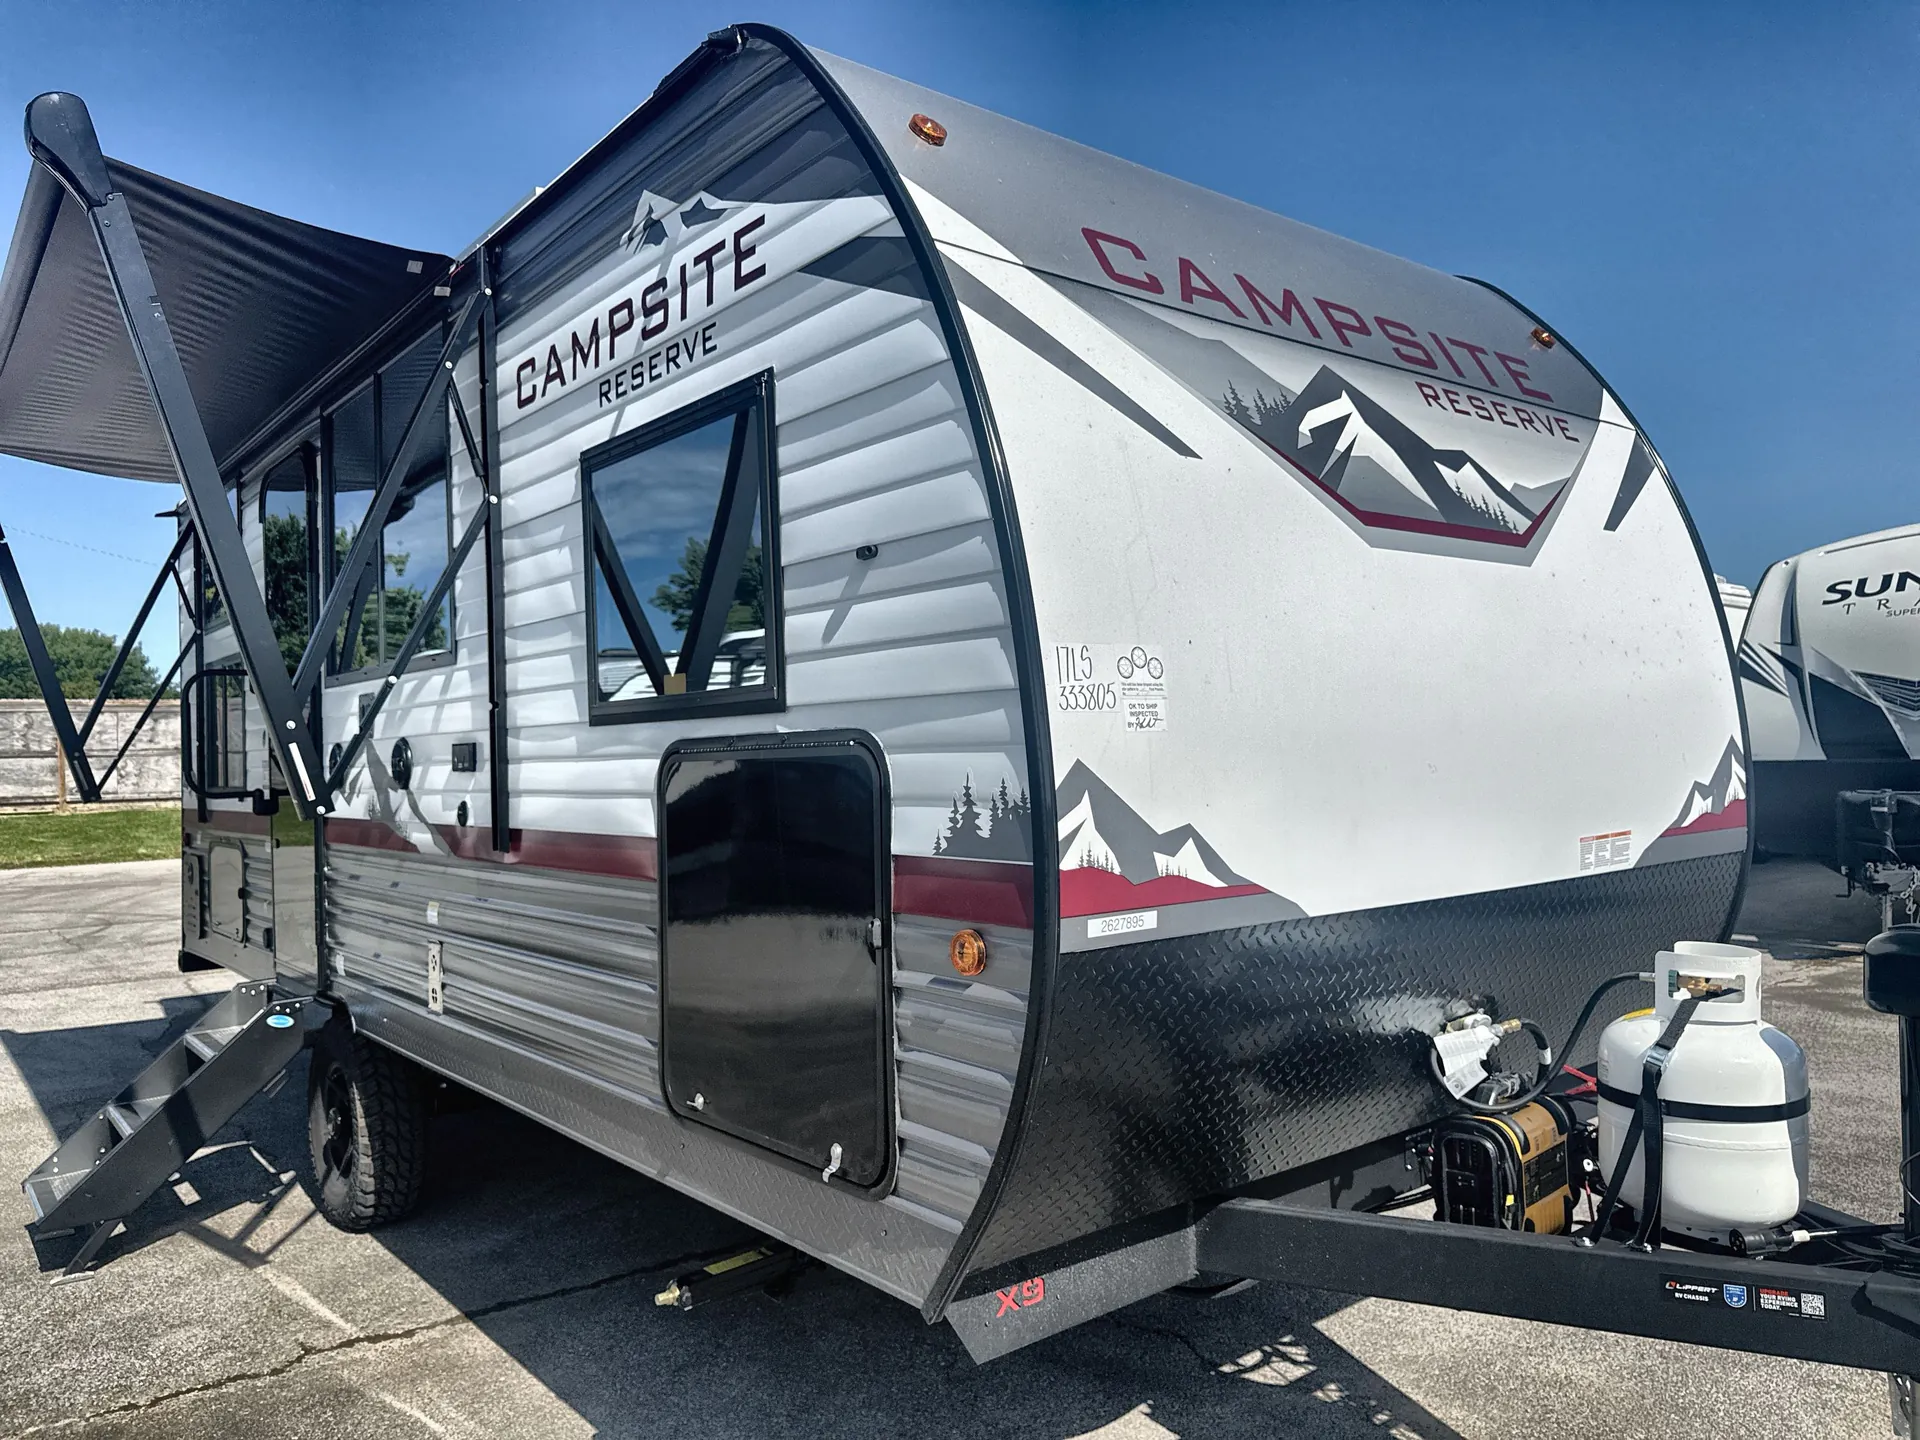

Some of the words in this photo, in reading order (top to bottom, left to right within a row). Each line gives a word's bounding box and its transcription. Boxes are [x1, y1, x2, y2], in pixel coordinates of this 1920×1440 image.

[516, 213, 767, 410] CAMPSITE
[1081, 227, 1554, 403] CAMPSITE
[599, 321, 718, 408] RESERVE
[1415, 381, 1580, 443] RESERVE
[1056, 644, 1092, 684] 17LS
[1059, 682, 1116, 710] 333805
[1101, 914, 1145, 933] 2627895
[996, 1276, 1045, 1318] X9
[1684, 1293, 1709, 1302] CHASSIS
[1760, 1299, 1799, 1308] EXPERIENCE
